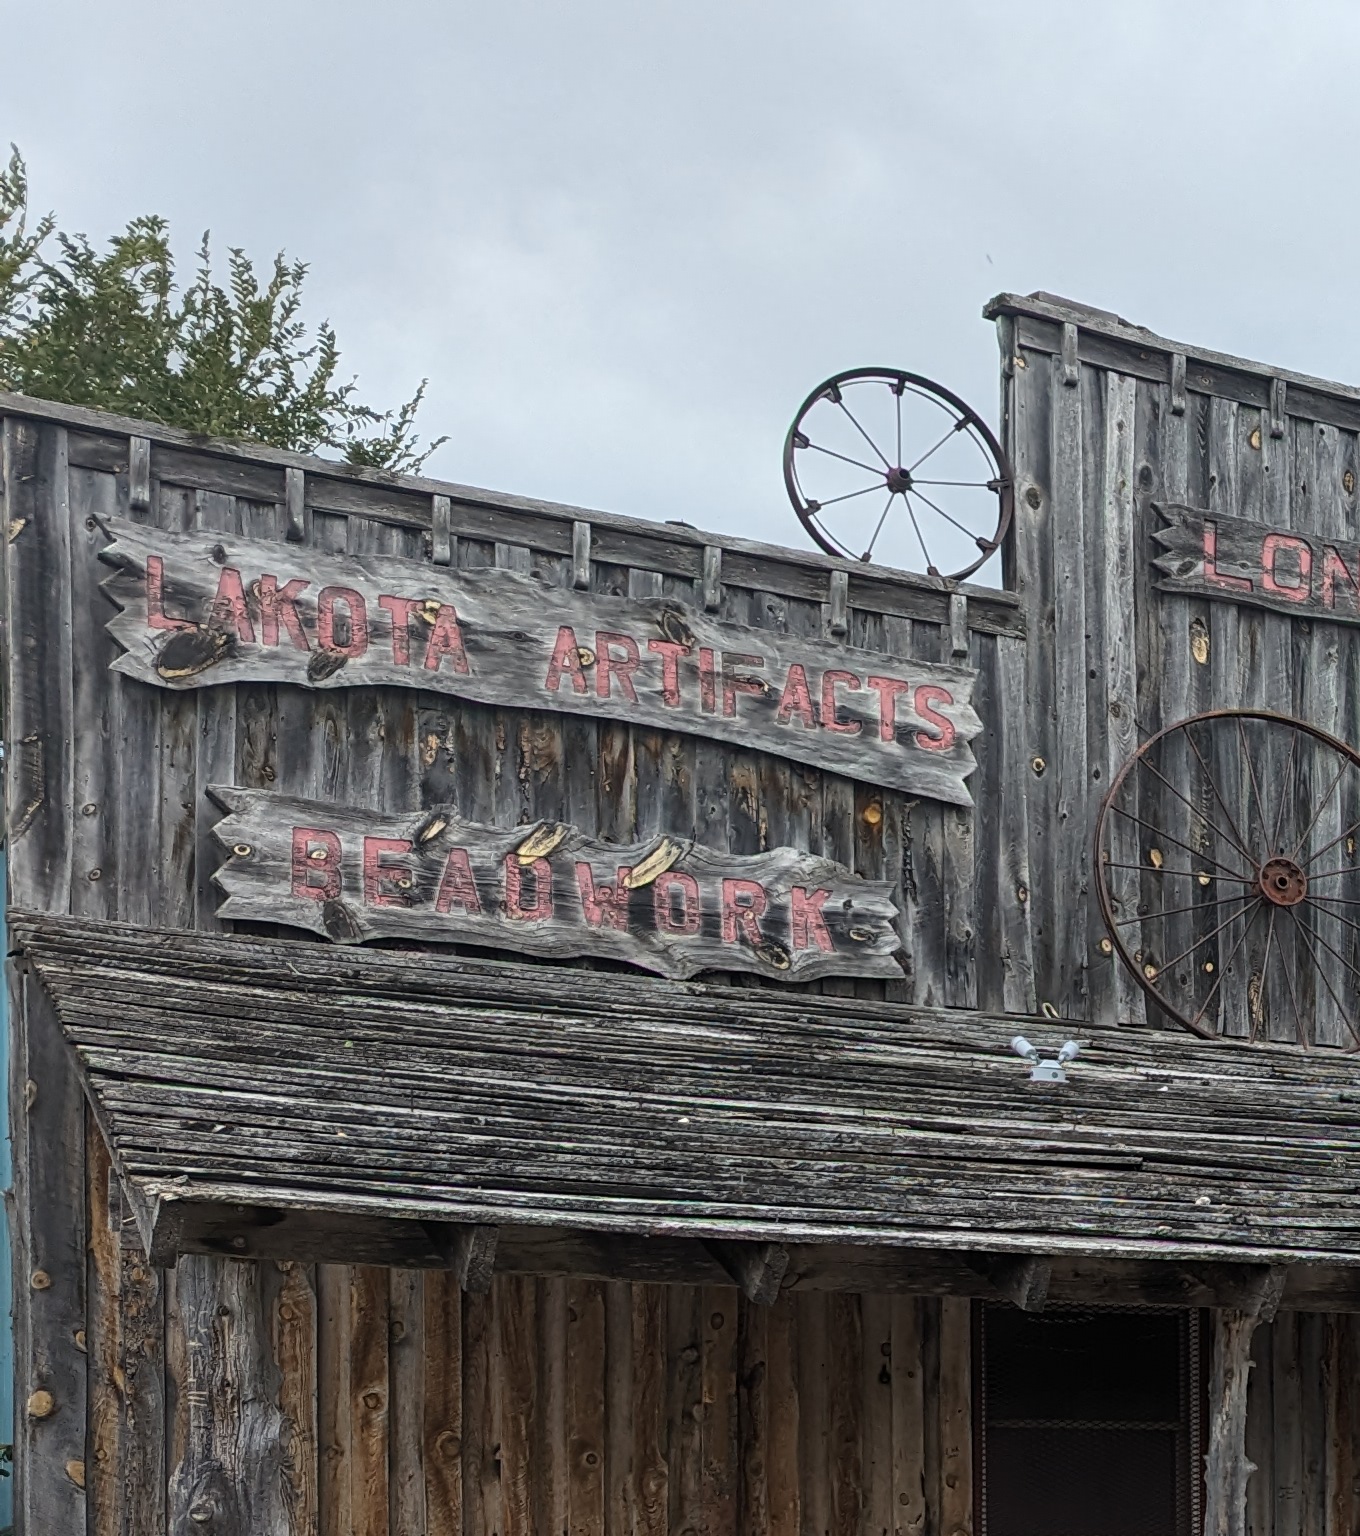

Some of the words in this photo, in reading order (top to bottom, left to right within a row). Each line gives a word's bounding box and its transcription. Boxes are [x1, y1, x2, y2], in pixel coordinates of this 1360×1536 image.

[146, 555, 471, 675] LAKOTA
[545, 625, 957, 753] ARTIFACTS
[291, 826, 836, 953] BEADWORK
